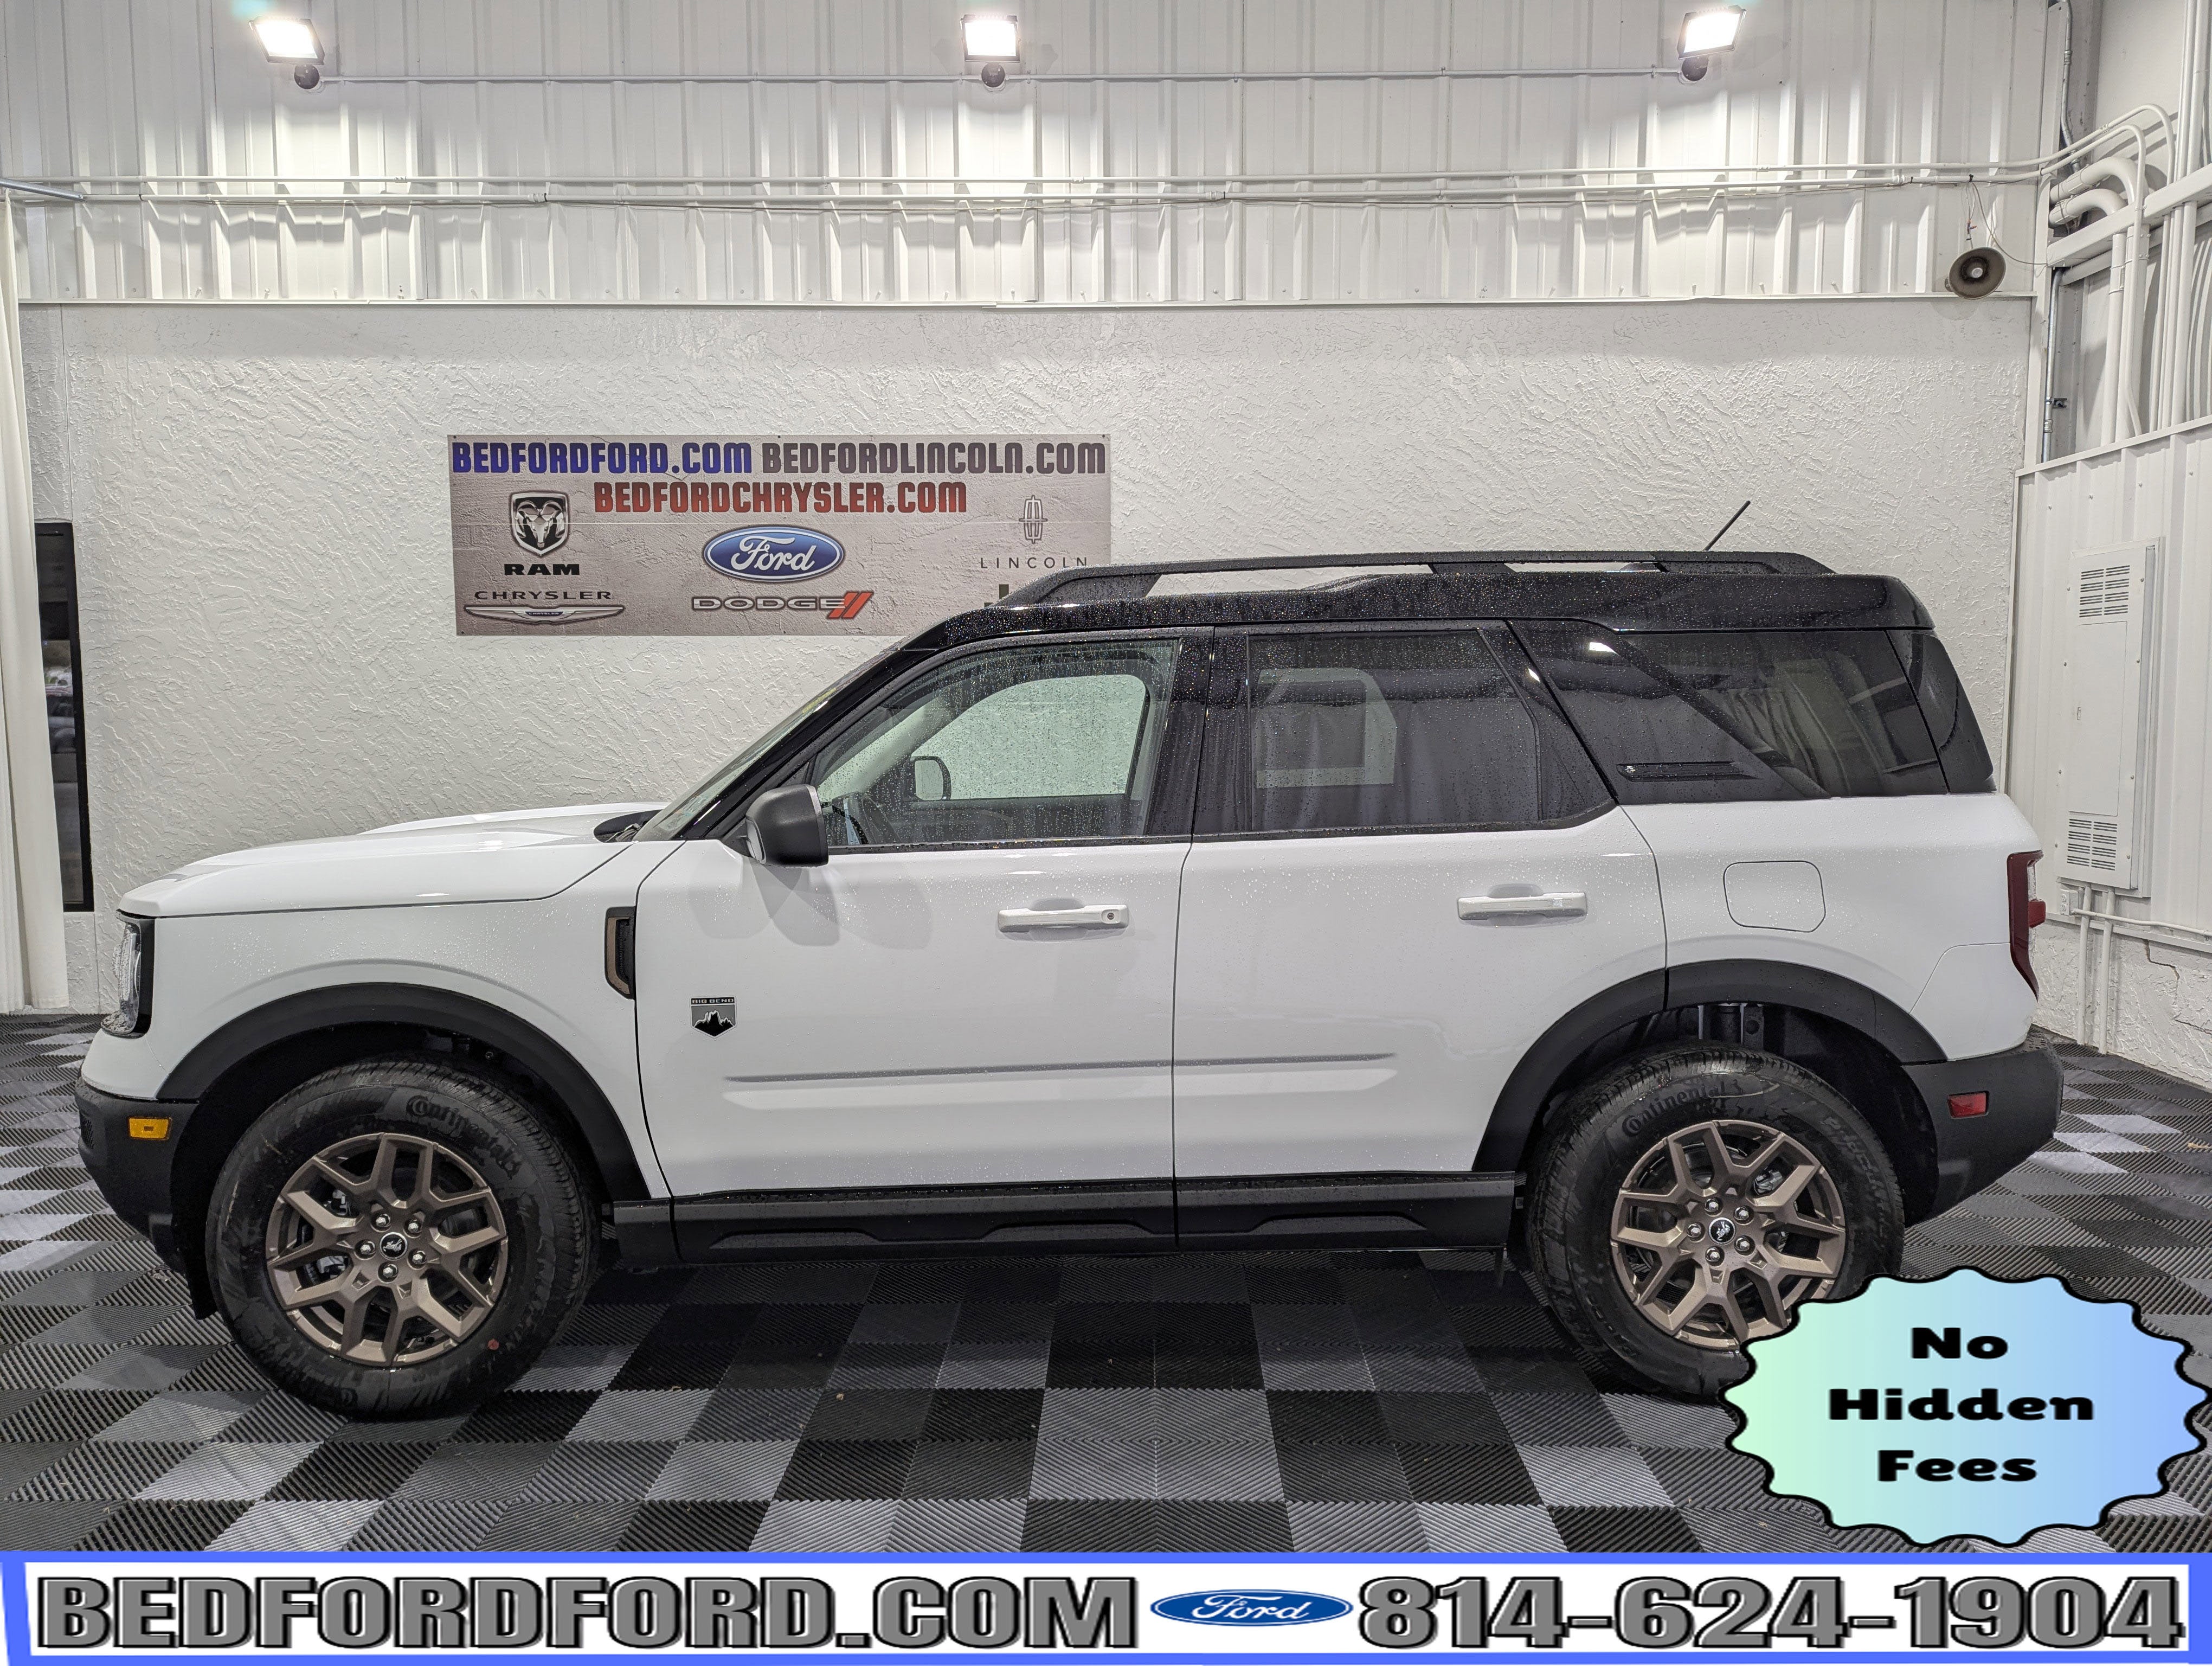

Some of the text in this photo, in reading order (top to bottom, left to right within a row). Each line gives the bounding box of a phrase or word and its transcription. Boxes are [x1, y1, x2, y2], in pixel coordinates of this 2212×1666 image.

[452, 442, 752, 474] BEDFORDFORD.COM
[762, 442, 1106, 474] BEDFORDLINCOLN.COM
[594, 482, 967, 513] BEDFORDCHRYSLER.COM
[730, 535, 817, 571] Ford
[980, 557, 1087, 568] LINCOLN
[504, 563, 580, 575] RAM
[474, 591, 612, 600] CHRYSLER
[692, 598, 846, 610] DODGE
